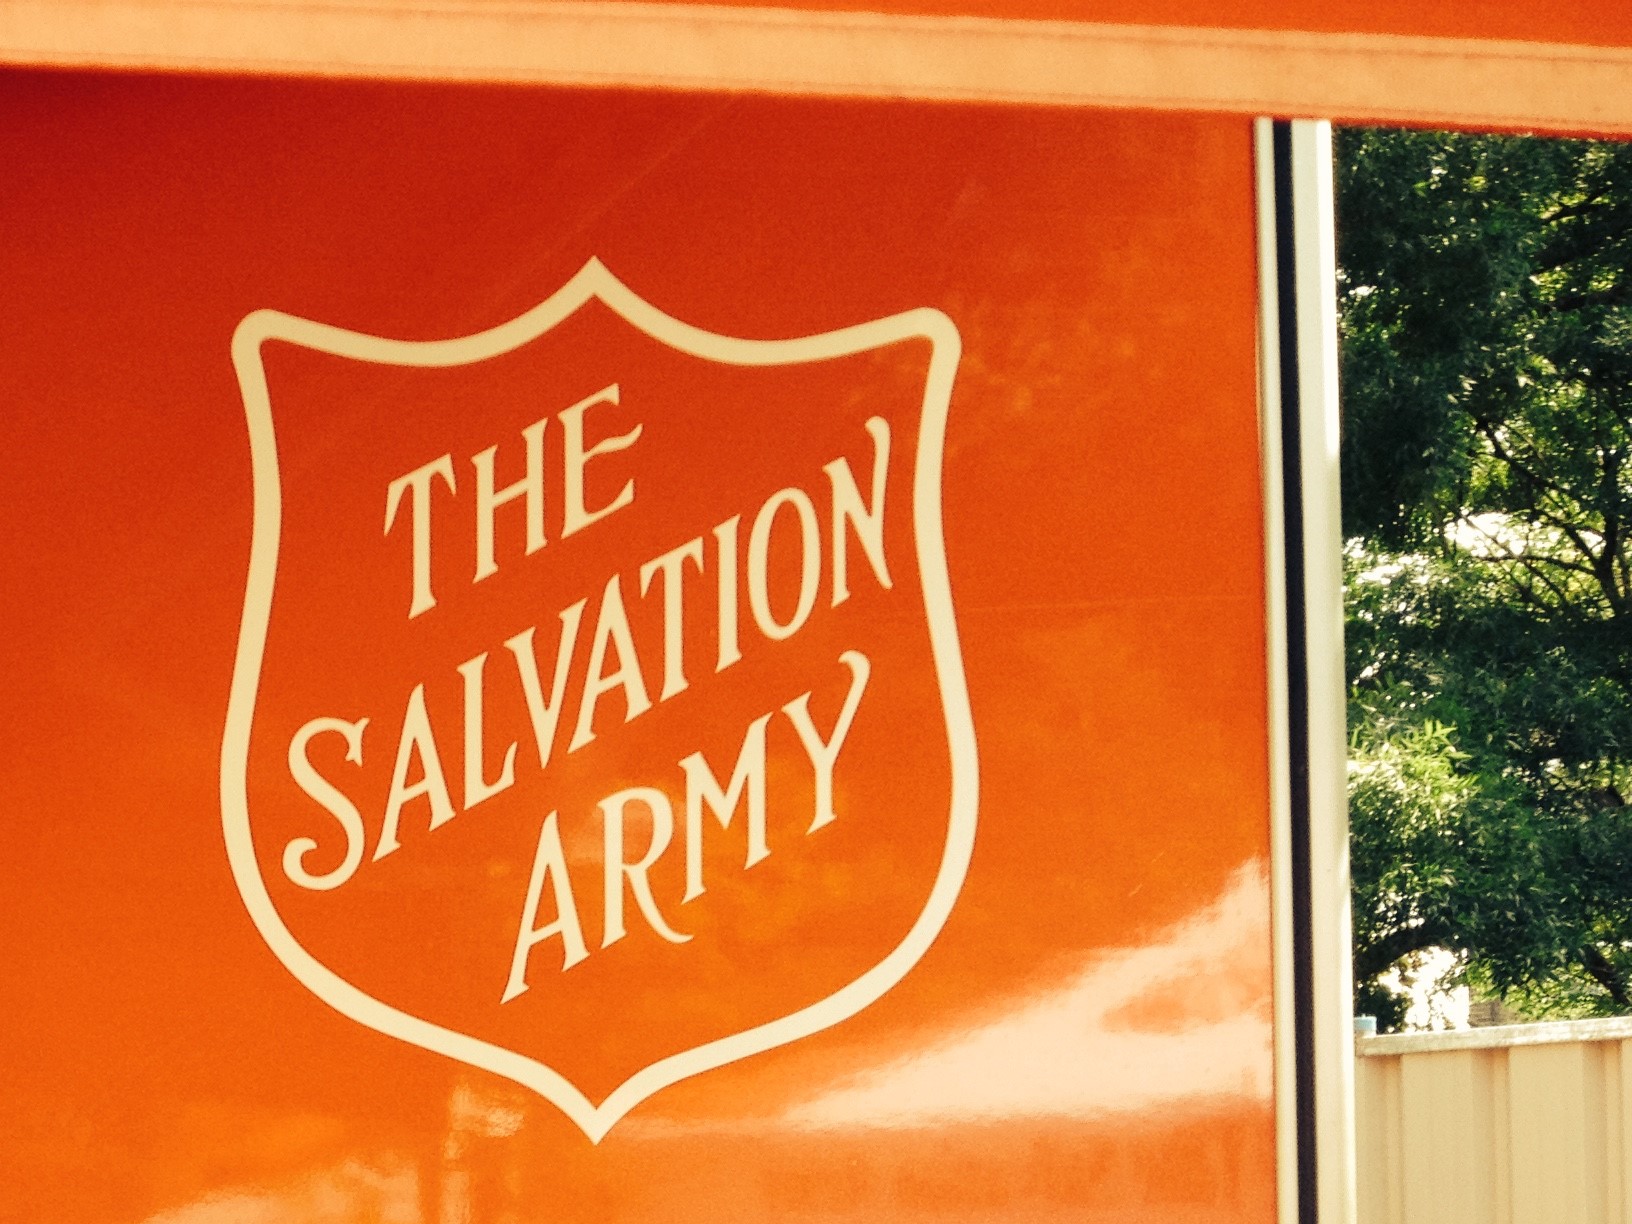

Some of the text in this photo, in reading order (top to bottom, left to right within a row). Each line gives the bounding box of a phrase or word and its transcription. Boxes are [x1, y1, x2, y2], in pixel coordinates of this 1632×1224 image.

[281, 415, 893, 891] SALVATION
[382, 383, 643, 620] THE
[500, 649, 871, 1004] ARMY
